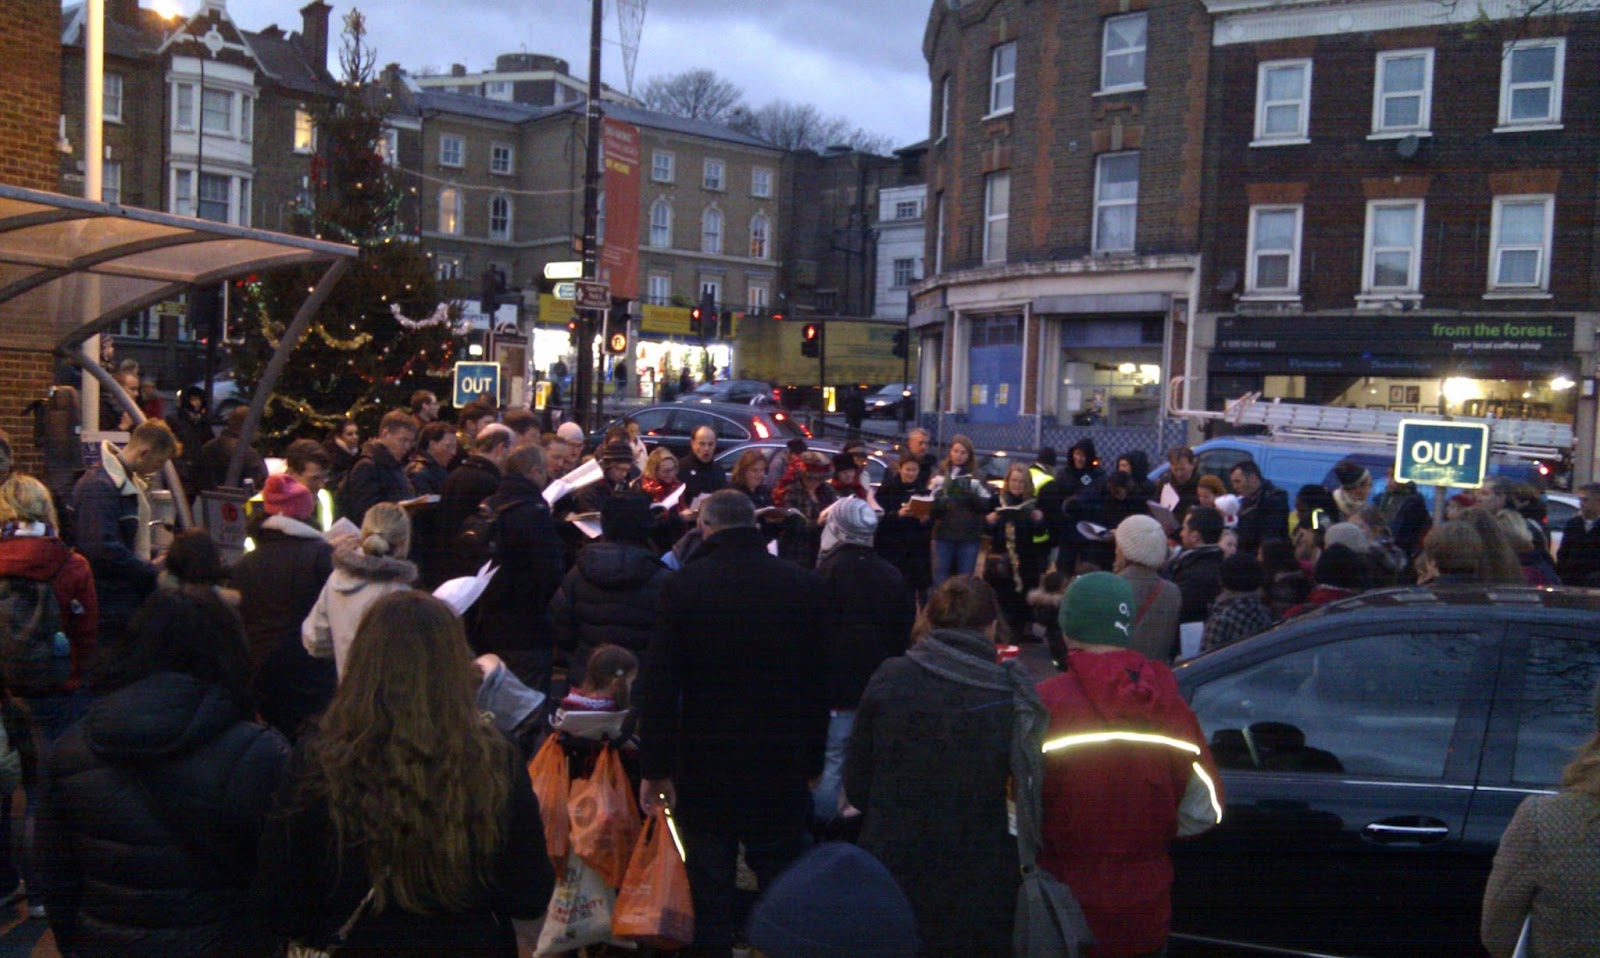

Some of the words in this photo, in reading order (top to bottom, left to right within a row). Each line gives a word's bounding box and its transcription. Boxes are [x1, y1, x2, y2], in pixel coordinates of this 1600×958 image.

[1432, 322, 1471, 337] from
[1474, 322, 1500, 337] the
[1473, 341, 1493, 350] local
[1493, 341, 1519, 350] coffee
[1520, 341, 1542, 351] shop
[461, 377, 493, 394] OUT
[1411, 440, 1472, 466] OUT
